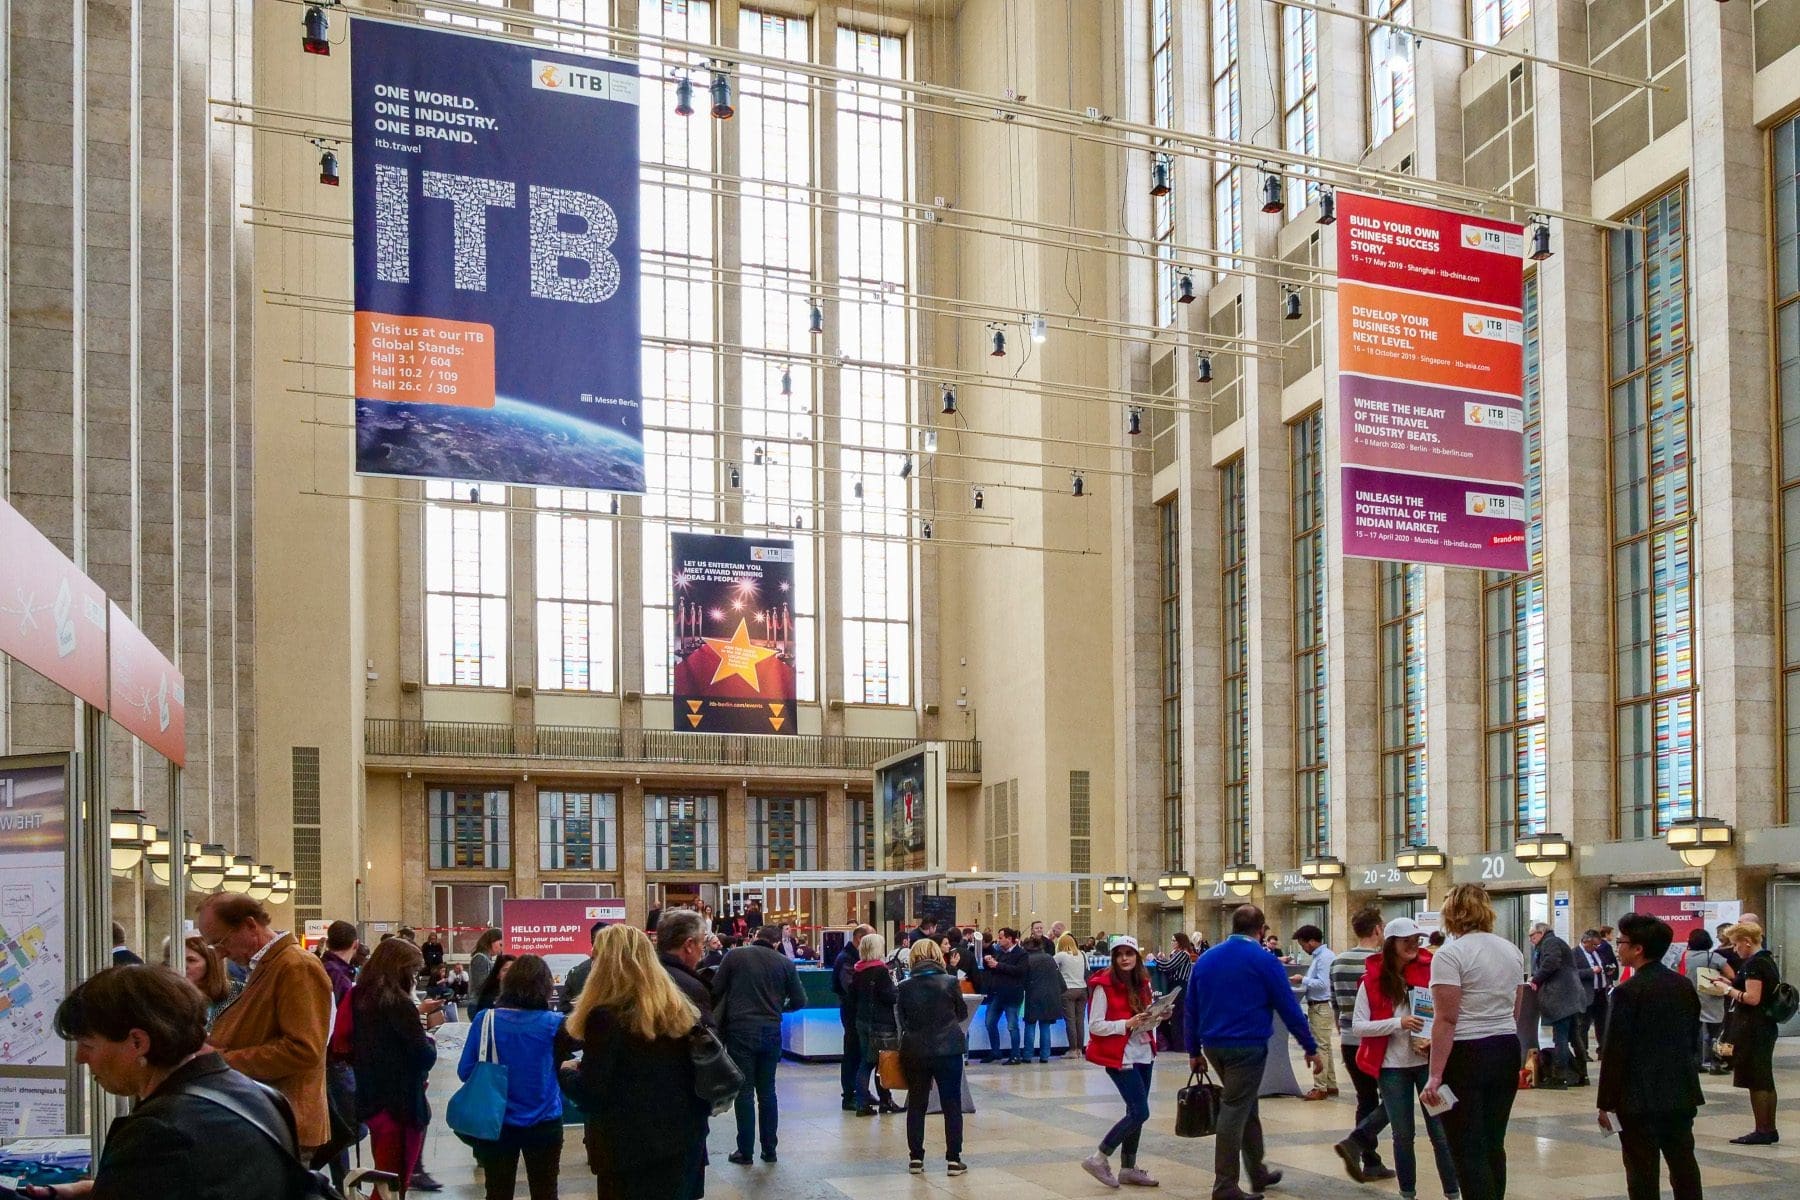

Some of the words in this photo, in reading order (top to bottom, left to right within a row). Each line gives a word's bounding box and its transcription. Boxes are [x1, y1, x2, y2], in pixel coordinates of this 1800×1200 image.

[569, 73, 602, 91] ITB
[374, 84, 409, 101] ONE
[415, 90, 478, 110] WORLD.
[374, 102, 409, 118] ONE
[416, 108, 499, 131] INDUSTRY.
[374, 118, 409, 136] ONE
[416, 125, 478, 145] BRAND.
[375, 140, 422, 154] itb.travel
[374, 163, 620, 304] ITB
[1350, 215, 1380, 229] BUILD
[1383, 222, 1411, 234] YOUR
[1414, 228, 1439, 239] OWN
[1350, 228, 1393, 244] CHINESE
[1396, 236, 1439, 252] SUCCESS
[1485, 232, 1500, 243] ITB
[1351, 241, 1386, 255] STORY.
[1351, 254, 1358, 262] 15
[1365, 256, 1372, 264] 17
[1373, 259, 1387, 268] May
[1388, 261, 1403, 270] 2019
[1408, 264, 1435, 275] Shanghai
[1440, 269, 1480, 283] itb-china.com
[1353, 306, 1398, 321] DEVELOP
[1401, 314, 1428, 327] YOUR
[1487, 320, 1502, 330] ITB
[371, 322, 400, 336] Visit
[404, 328, 418, 337] us
[422, 328, 436, 338] at
[439, 330, 461, 340] our
[464, 332, 484, 343] ITB
[1353, 319, 1400, 334] BUSINESS
[1404, 327, 1416, 338] TO
[1420, 330, 1438, 341] THE
[372, 337, 414, 352] Global
[418, 341, 464, 356] Stands:
[1353, 332, 1378, 344] NEXT
[1381, 337, 1414, 349] LEVEL.
[372, 352, 394, 364] Hall
[398, 354, 415, 364] 3.1
[430, 356, 450, 368] 604
[1375, 348, 1400, 359] October
[1401, 352, 1416, 361] 2019
[1421, 355, 1450, 366] Singapore
[1455, 361, 1490, 372] itb-asia.com
[372, 366, 394, 377] Hall
[399, 368, 422, 378] 10.2
[438, 370, 458, 381] 109
[372, 379, 394, 390] Hall
[398, 381, 422, 392] 26.c
[436, 383, 457, 394] 309
[594, 396, 617, 406] Messe
[618, 398, 638, 408] Berlin
[1354, 398, 1389, 411] WHERE
[1392, 403, 1410, 415] THE
[1413, 406, 1445, 419] HEART
[1355, 411, 1367, 420] OF
[1370, 414, 1388, 424] THE
[1391, 416, 1429, 429] TRAVEL
[1488, 408, 1503, 418] ITB
[1355, 424, 1403, 438] INDUSTRY
[1407, 431, 1441, 443] BEATS.
[1370, 439, 1389, 448] March
[1391, 442, 1405, 450] 2020
[1410, 444, 1427, 452] Berlin
[1432, 447, 1473, 458] itb-berlin.com
[1356, 491, 1402, 504] UNLEASH
[1405, 496, 1423, 507] THE
[1490, 498, 1504, 507] ITB
[1356, 504, 1410, 518] POTENTIAL
[1413, 510, 1426, 520] OF
[1428, 512, 1447, 522] THE
[1356, 517, 1393, 529] INDIAN
[1396, 522, 1439, 534] MARKET.
[1379, 533, 1393, 541] April
[1395, 534, 1409, 542] 2020
[1414, 536, 1438, 545] Mumbai
[1444, 539, 1482, 549] itb-india.com
[1364, 870, 1377, 884] 20
[1388, 869, 1400, 881] 26
[1482, 857, 1504, 879] 20
[1213, 880, 1226, 896] 20
